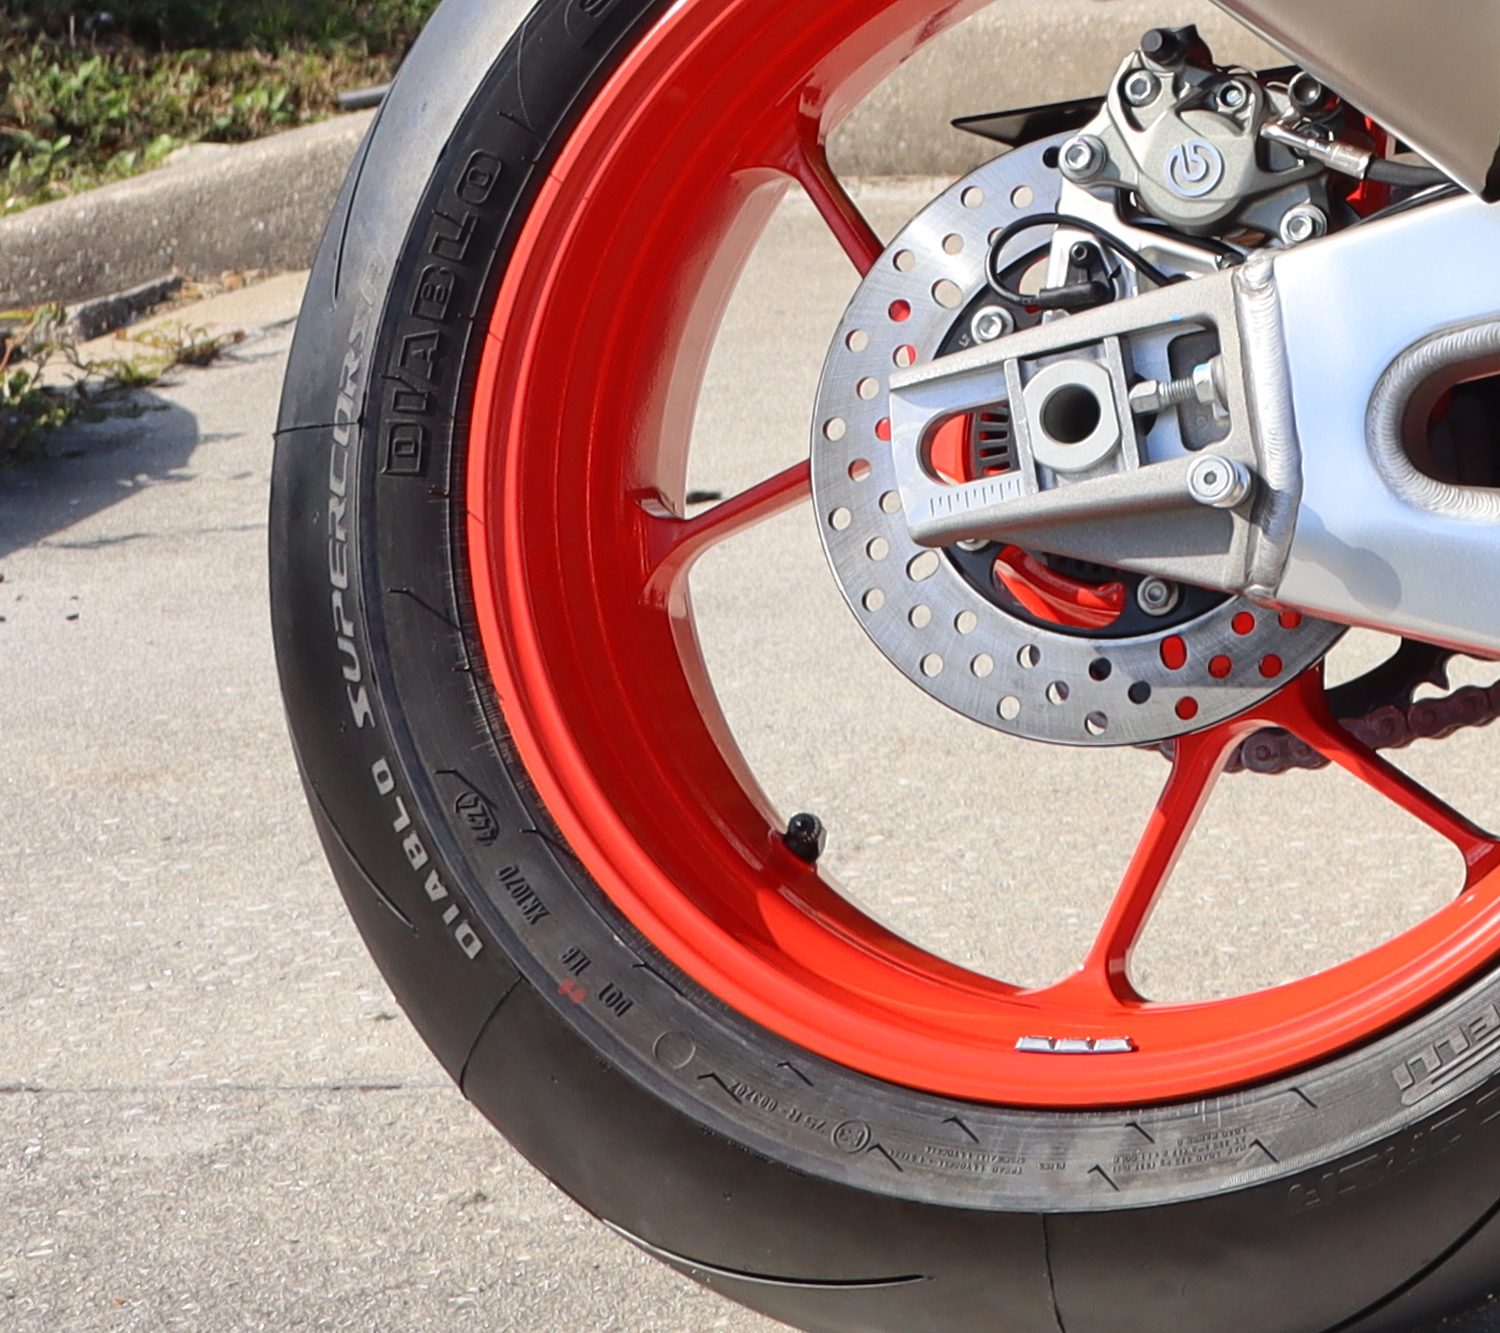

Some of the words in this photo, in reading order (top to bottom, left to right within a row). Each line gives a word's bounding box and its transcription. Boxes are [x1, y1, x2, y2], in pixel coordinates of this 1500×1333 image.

[381, 146, 504, 472] DIABLO
[327, 244, 386, 727] SUPERCORSA
[367, 757, 484, 959] DIABLO
[595, 981, 633, 1017] DOT
